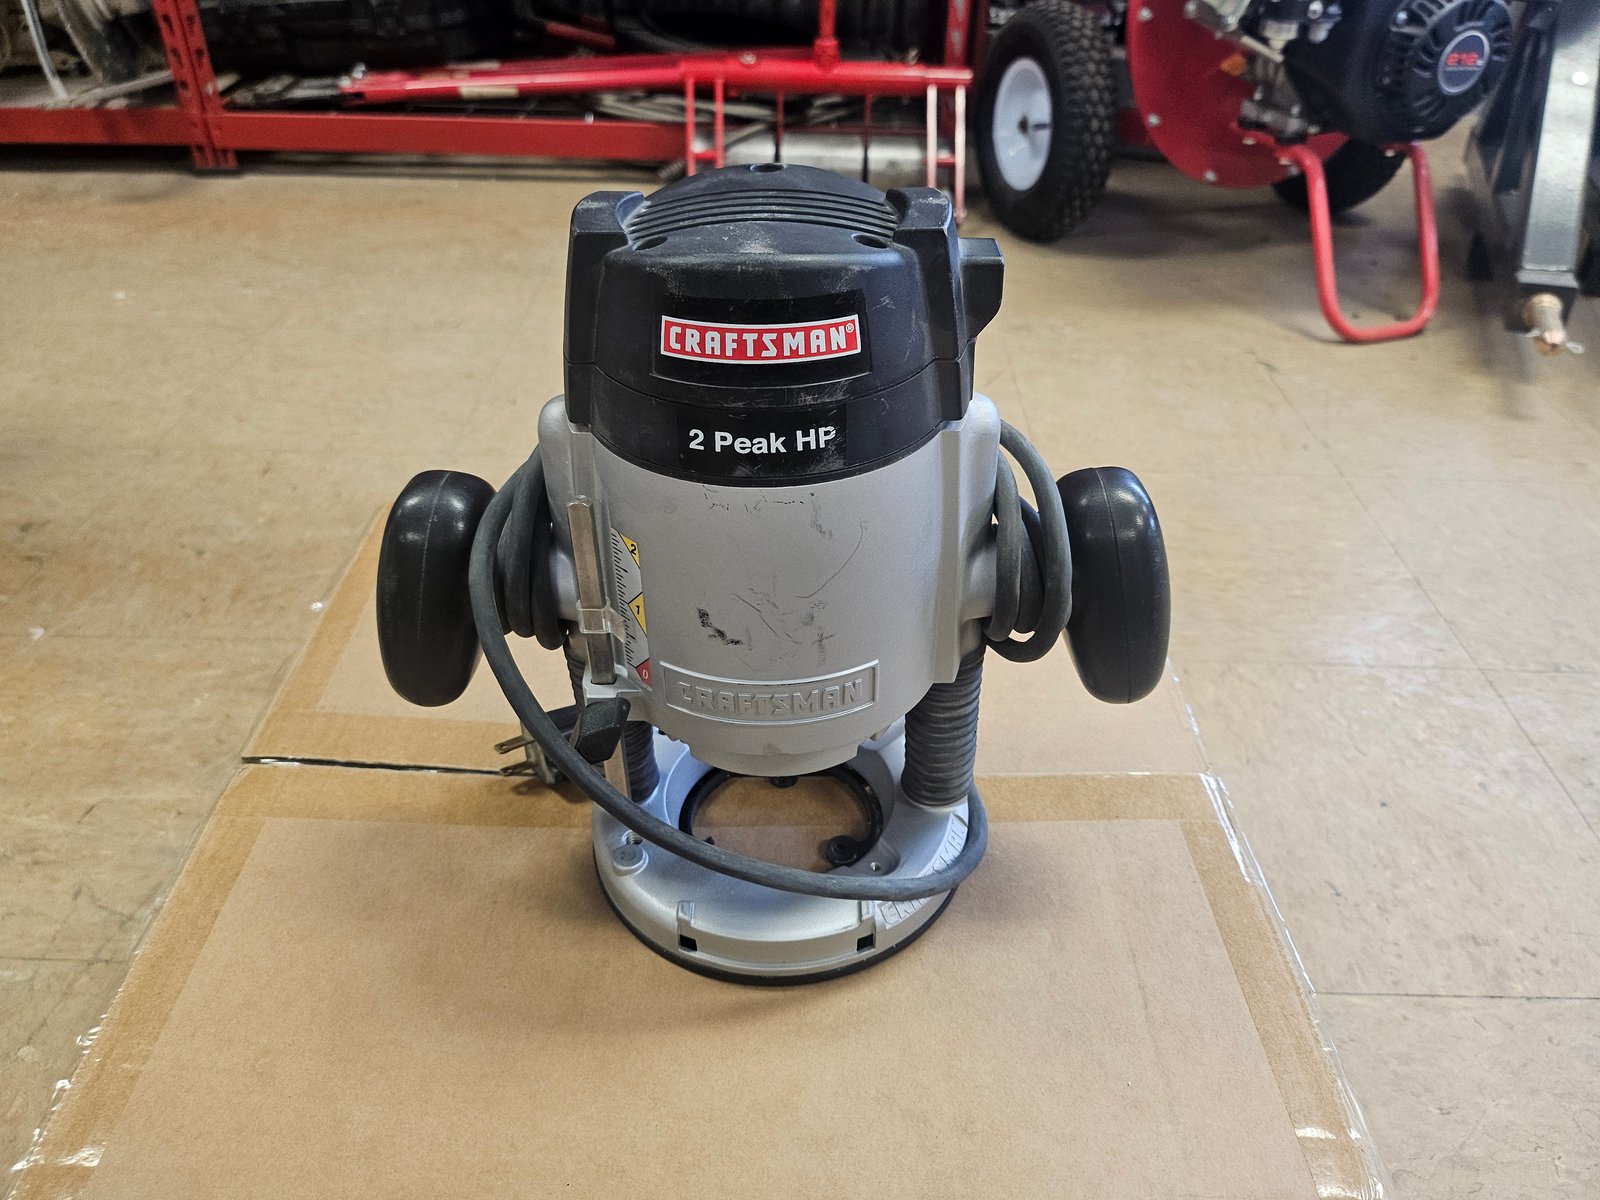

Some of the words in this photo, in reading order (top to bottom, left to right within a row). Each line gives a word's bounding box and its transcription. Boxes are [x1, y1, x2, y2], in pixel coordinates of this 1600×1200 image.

[689, 429, 705, 451] 2
[714, 431, 786, 454] Peak
[796, 426, 836, 451] HP
[630, 543, 637, 556] 2
[635, 605, 640, 615] 1
[642, 669, 649, 679] 0
[678, 678, 862, 716] CRAFTSMAN
